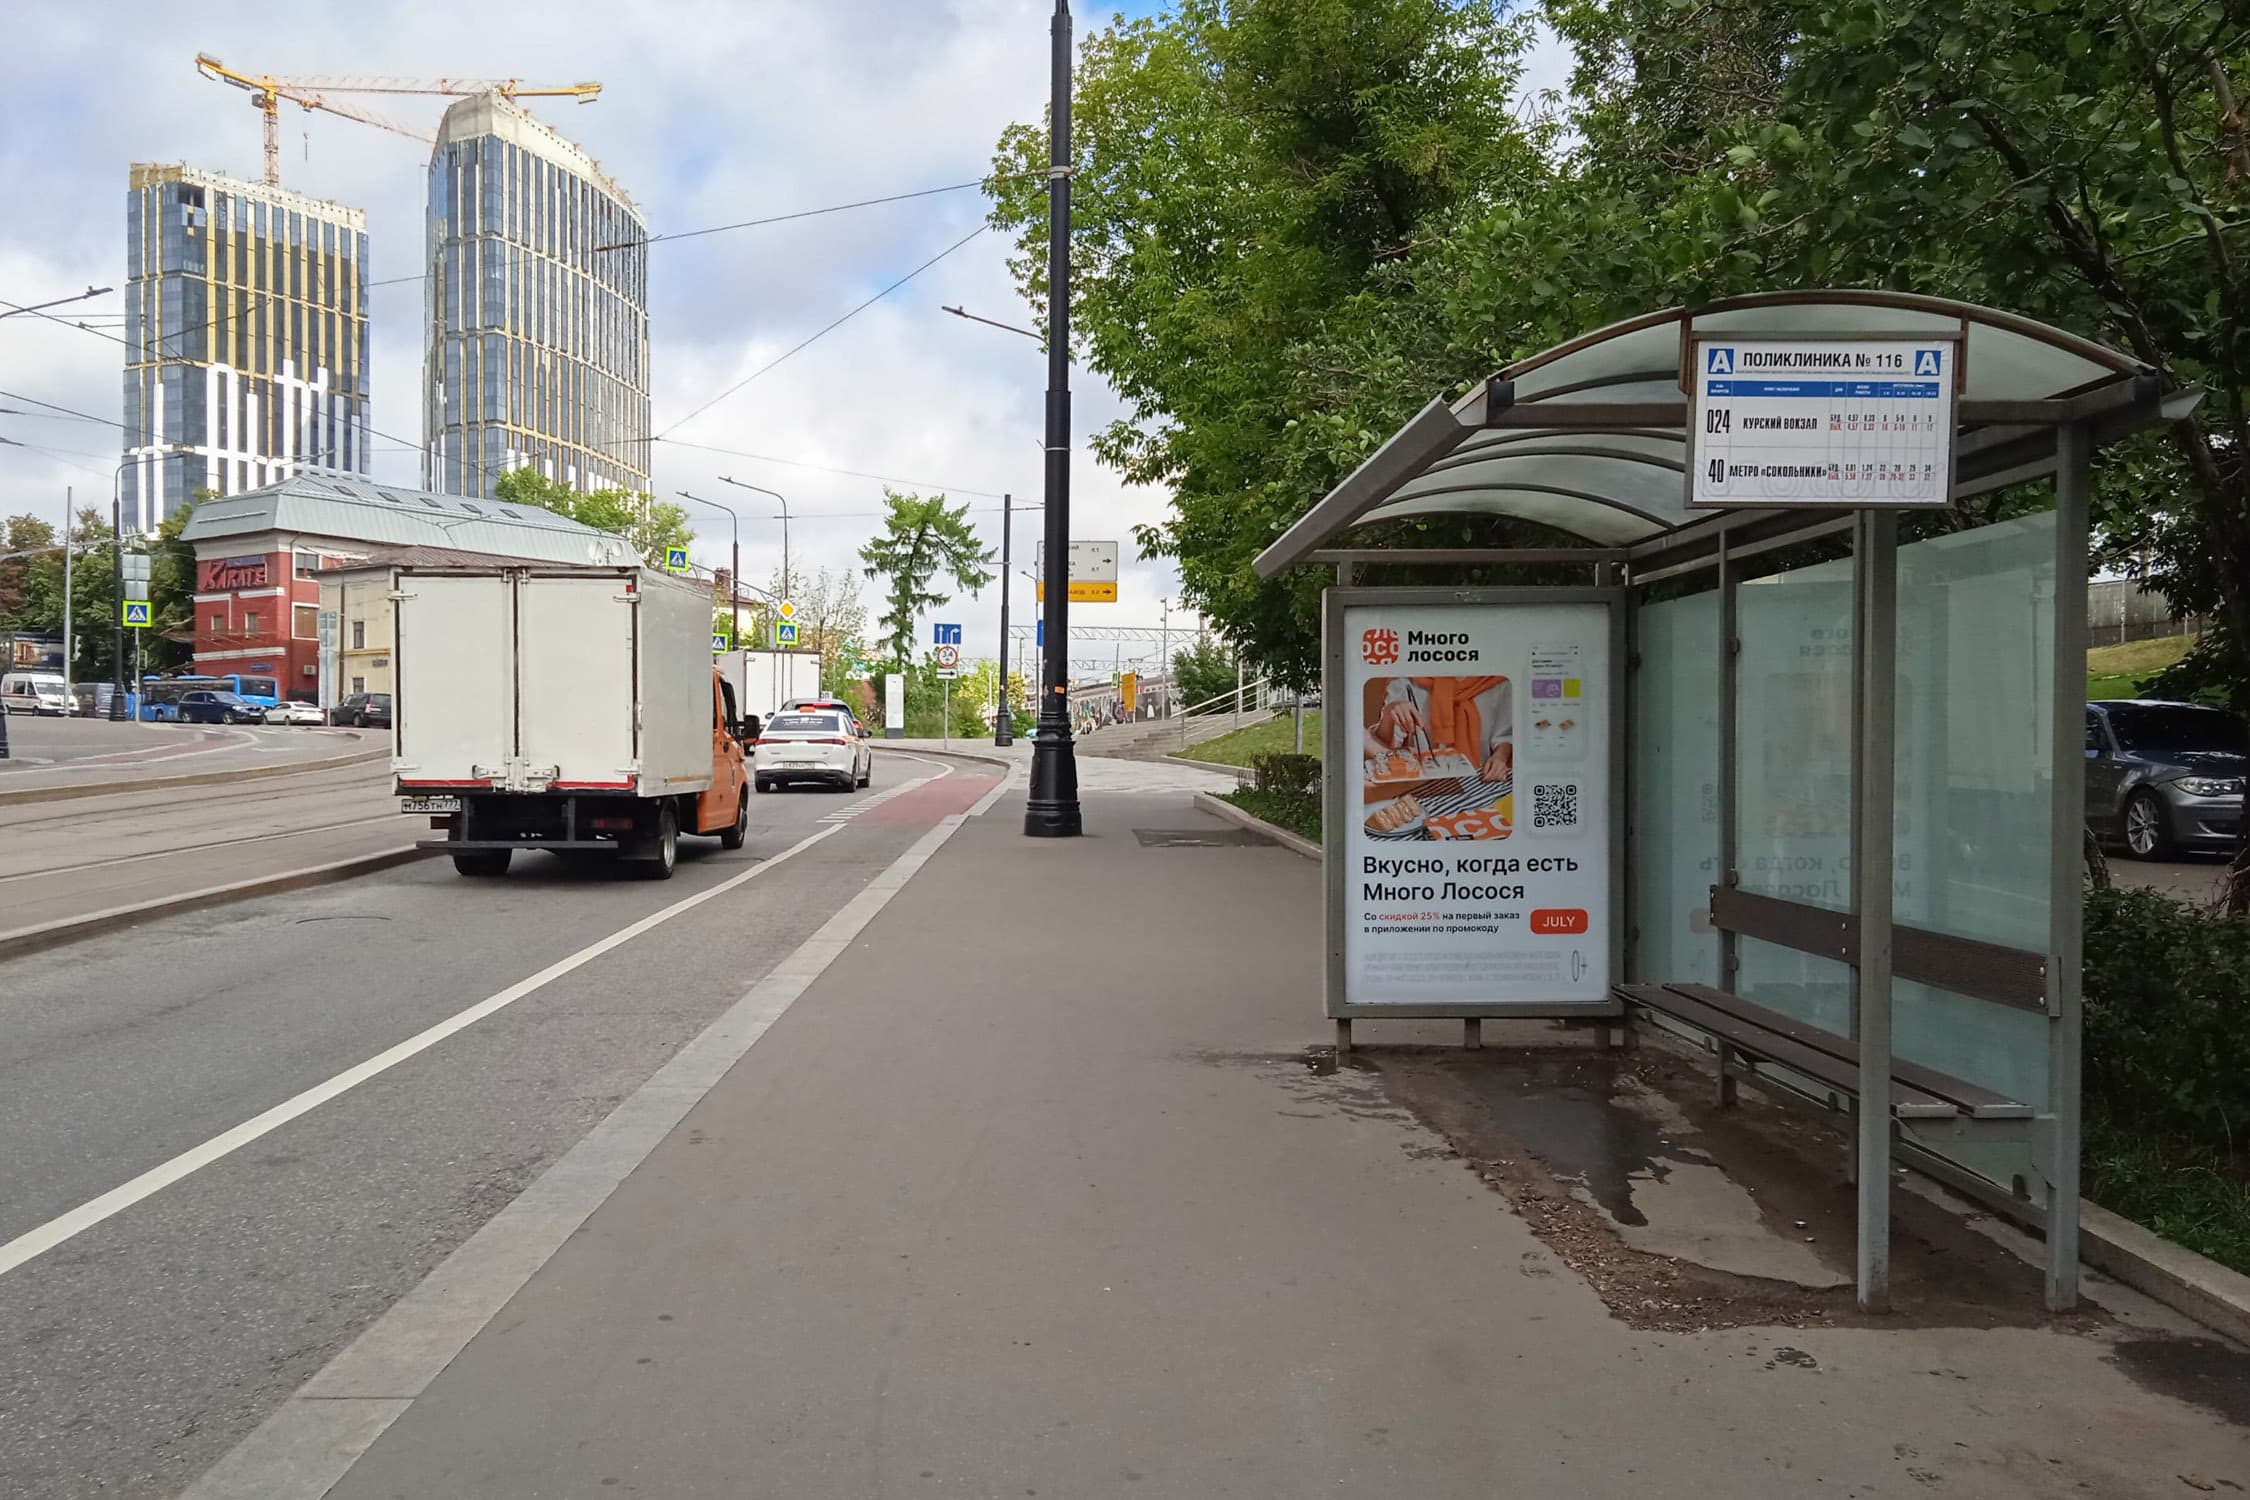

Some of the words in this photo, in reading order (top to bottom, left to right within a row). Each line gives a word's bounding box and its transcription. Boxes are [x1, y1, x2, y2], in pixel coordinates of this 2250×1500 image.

[1743, 352, 1852, 368] ПОЛИКЛИНИКА
[1855, 353, 1871, 368] №
[1875, 353, 1903, 368] 116
[1707, 409, 1730, 434] 024
[1743, 416, 1782, 430] КУРСКИЙ
[1784, 417, 1817, 430] ВОКЗАЛ
[1708, 459, 1725, 483] 40
[1729, 465, 1759, 478] МЕТРО
[1760, 465, 1827, 478] «СОКОЛЬНИКИ»
[1407, 631, 1470, 646] Много
[1407, 649, 1479, 663] лосося
[1363, 856, 1450, 878] Вкусно,
[1456, 857, 1520, 877] когда
[1526, 857, 1579, 873] есть
[1363, 882, 1435, 901] Много
[1441, 882, 1525, 900] Лосося
[1364, 912, 1377, 921] Со
[1379, 912, 1419, 921] скидкой
[1421, 912, 1440, 921] 25%
[1442, 913, 1454, 921] на
[1456, 911, 1492, 922] первый
[1494, 912, 1520, 920] заказ
[1543, 916, 1576, 928] JULY
[1372, 926, 1431, 935] приложении
[1433, 925, 1445, 933] по
[1446, 925, 1500, 935] промокоду
